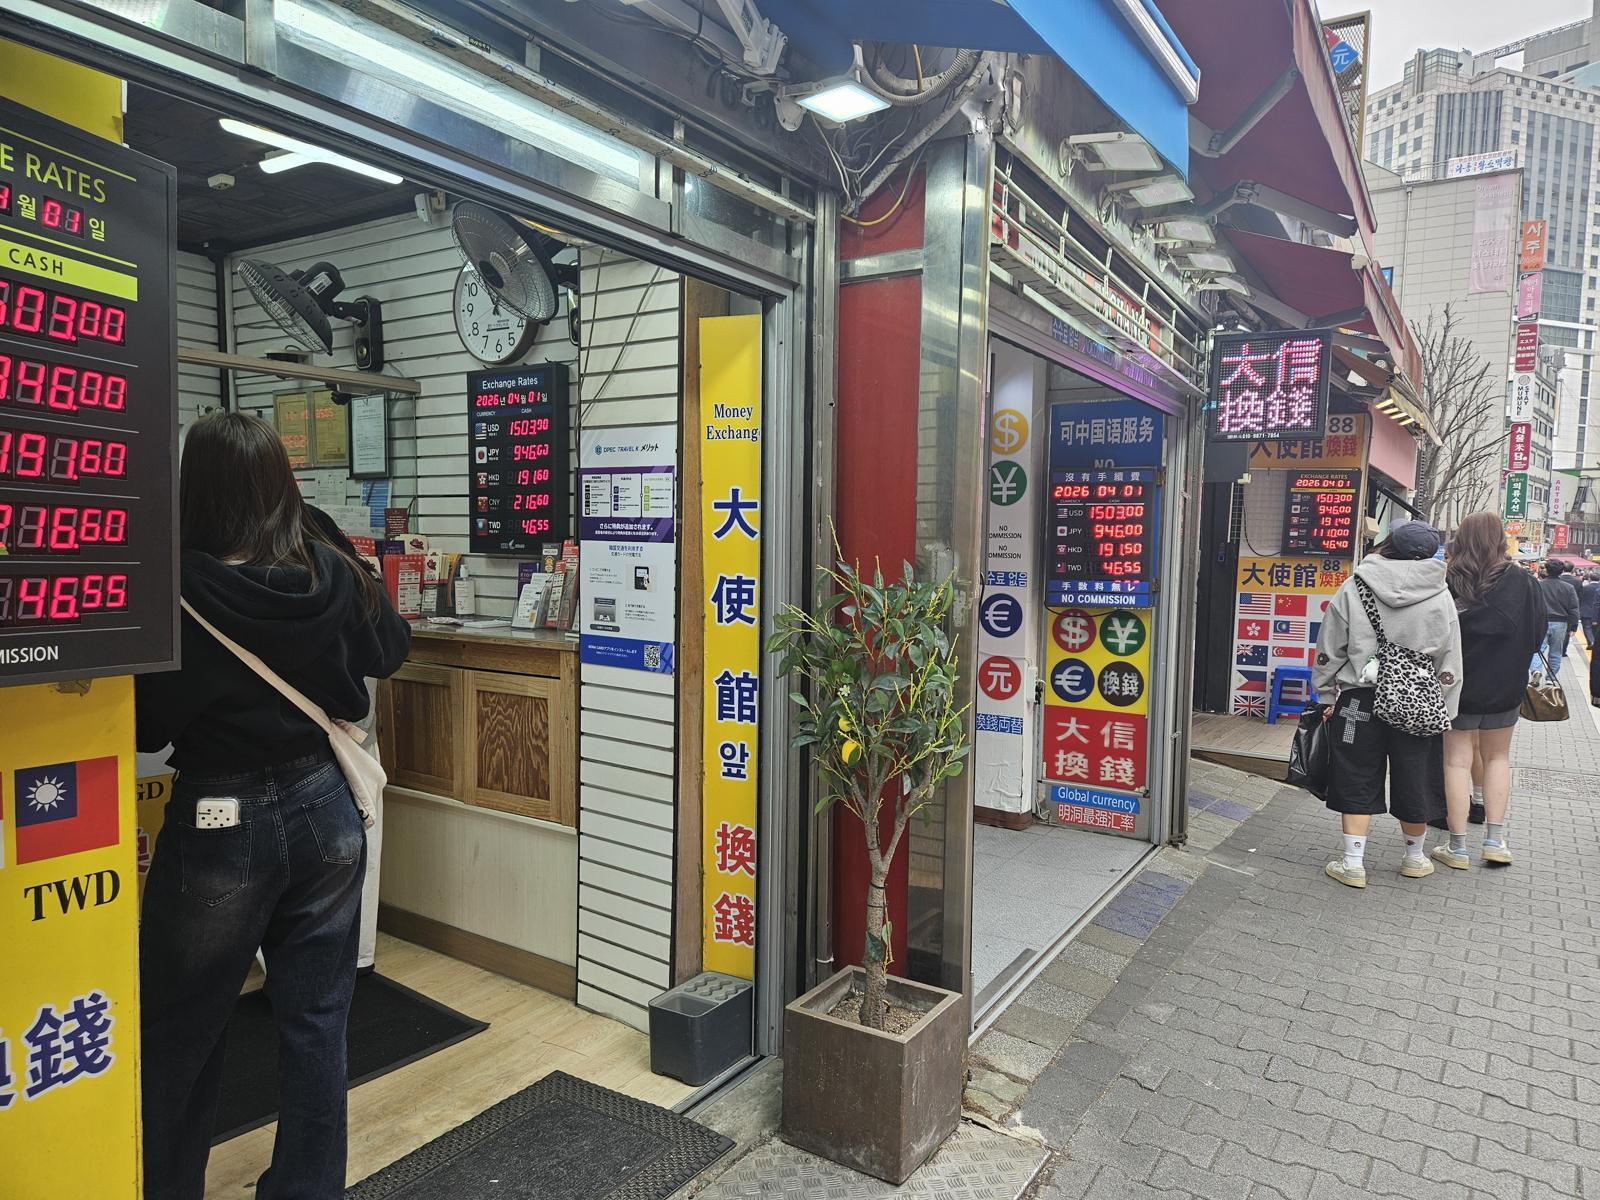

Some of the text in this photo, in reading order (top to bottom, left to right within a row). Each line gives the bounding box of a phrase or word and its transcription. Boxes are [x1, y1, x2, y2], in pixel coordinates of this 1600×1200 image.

[1333, 48, 1350, 66] 元
[26, 153, 106, 203] RATES
[17, 194, 37, 220] 월
[42, 199, 81, 233] 01
[89, 218, 105, 241] 일
[1526, 221, 1543, 255] 사주
[9, 249, 63, 276] CASH
[467, 282, 478, 297] 10
[466, 303, 474, 317] 9
[471, 322, 480, 337] 8
[482, 336, 489, 350] 7
[495, 339, 503, 353] 6
[508, 332, 516, 347] 5
[1219, 338, 1323, 388] 大信
[482, 377, 538, 390] Exchange Rates
[713, 403, 754, 421] Money
[1217, 386, 1314, 432] 換錢
[487, 424, 500, 433] USD
[706, 425, 760, 443] Exchang
[1060, 416, 1154, 445] 可中国语服务
[1328, 417, 1354, 434] 88
[488, 449, 500, 457] JPY
[641, 442, 659, 452] メリット
[489, 474, 500, 482] HKD
[1510, 482, 1522, 512] 의류수선
[1068, 509, 1084, 517] USD
[488, 521, 501, 530] TWD
[1068, 528, 1083, 536] JPY
[1241, 562, 1318, 588] 大使館
[1322, 560, 1342, 572] 88
[1009, 572, 1027, 588] 없음
[1061, 593, 1136, 605] NO COMMISSION
[0, 646, 59, 664] ISSION
[986, 662, 1013, 693] 元
[1103, 670, 1139, 698] 換錢
[1056, 716, 1137, 751] 大信
[1054, 749, 1137, 786] 換錢
[1057, 785, 1137, 814] Global currency
[1057, 803, 1136, 833] 明洞最强汇率
[24, 869, 121, 922] TWD
[0, 992, 113, 1107] 錢
